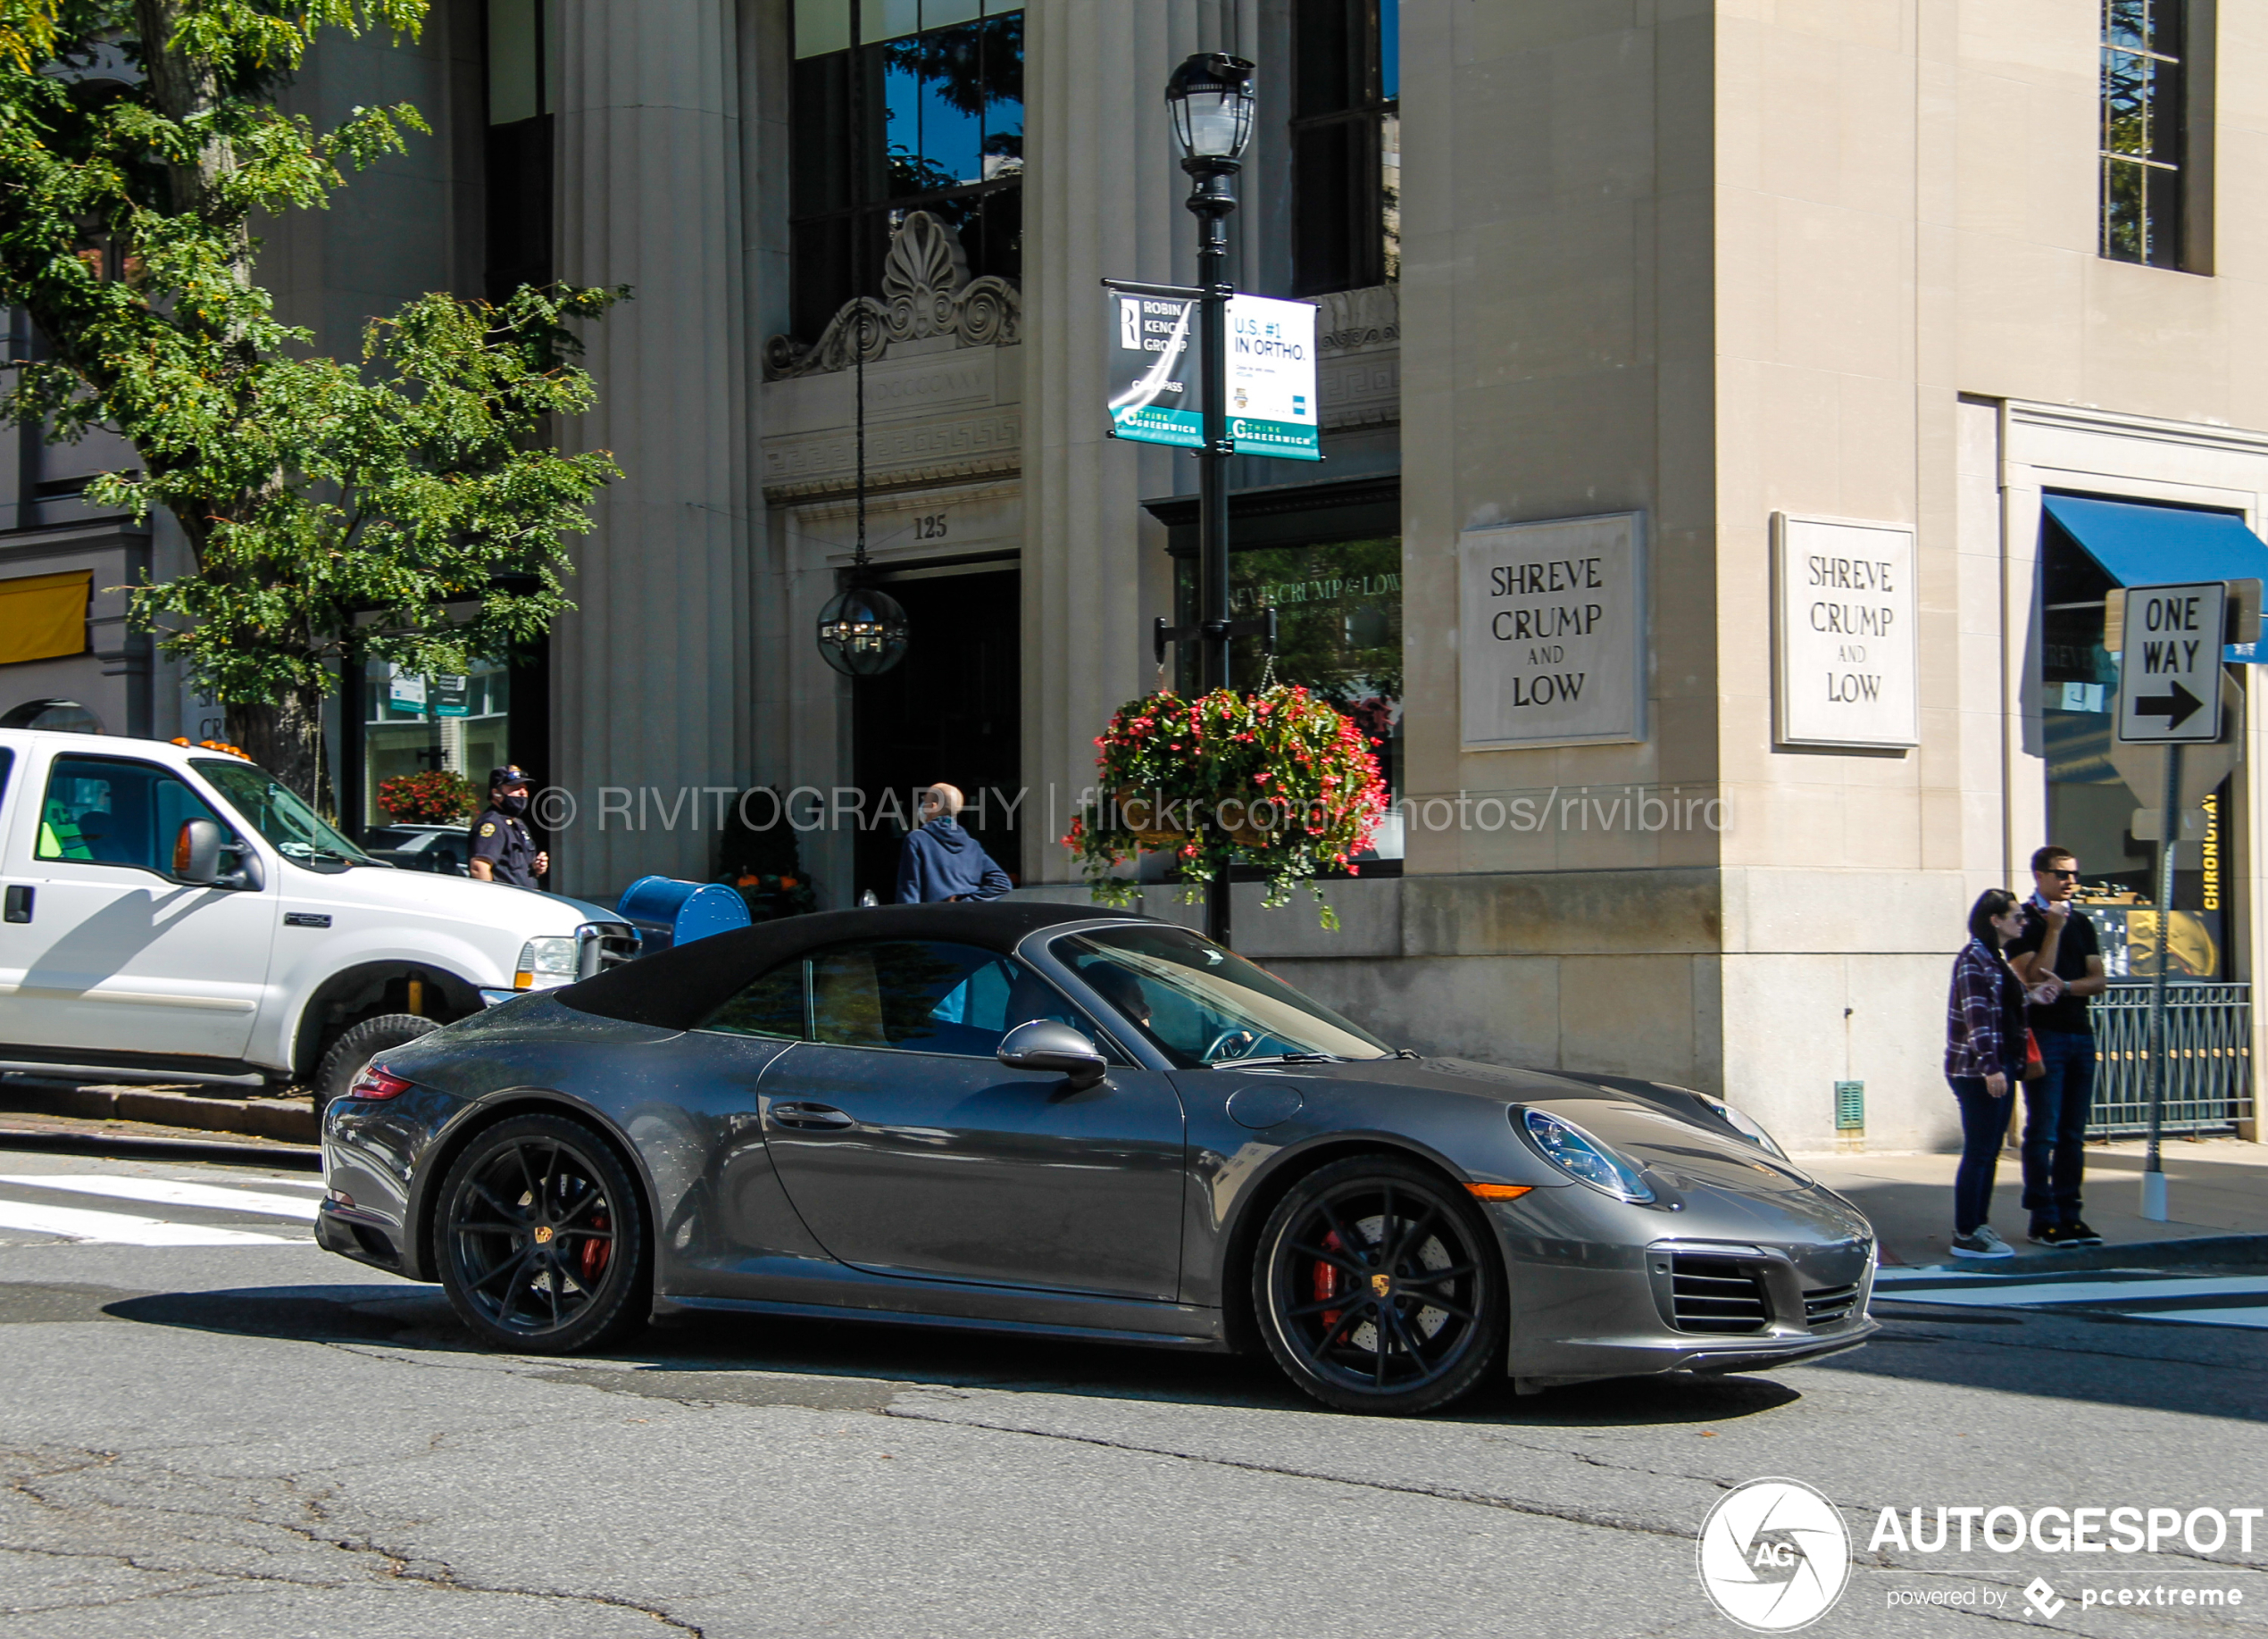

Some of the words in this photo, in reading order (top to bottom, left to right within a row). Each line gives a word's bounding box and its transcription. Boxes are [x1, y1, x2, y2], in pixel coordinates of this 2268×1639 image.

[1143, 301, 1181, 316] ROBIN
[1235, 317, 1261, 336] U.S.
[1265, 322, 1281, 338] #1
[1235, 337, 1249, 354] IN
[1254, 339, 1306, 361] ORTHO.
[913, 513, 947, 540] 125
[1490, 557, 1602, 597] SHREVE
[1809, 555, 1893, 593] SHREVE
[1278, 578, 1342, 603] CRUMP
[1492, 603, 1603, 641] CRUMP
[1810, 601, 1894, 637] CRUMP
[2146, 597, 2200, 632] ONE
[1527, 645, 1564, 666] AND
[1838, 645, 1866, 663] AND
[2143, 639, 2200, 674] WAY
[1513, 672, 1586, 707] LOW
[1827, 671, 1881, 703] LOW
